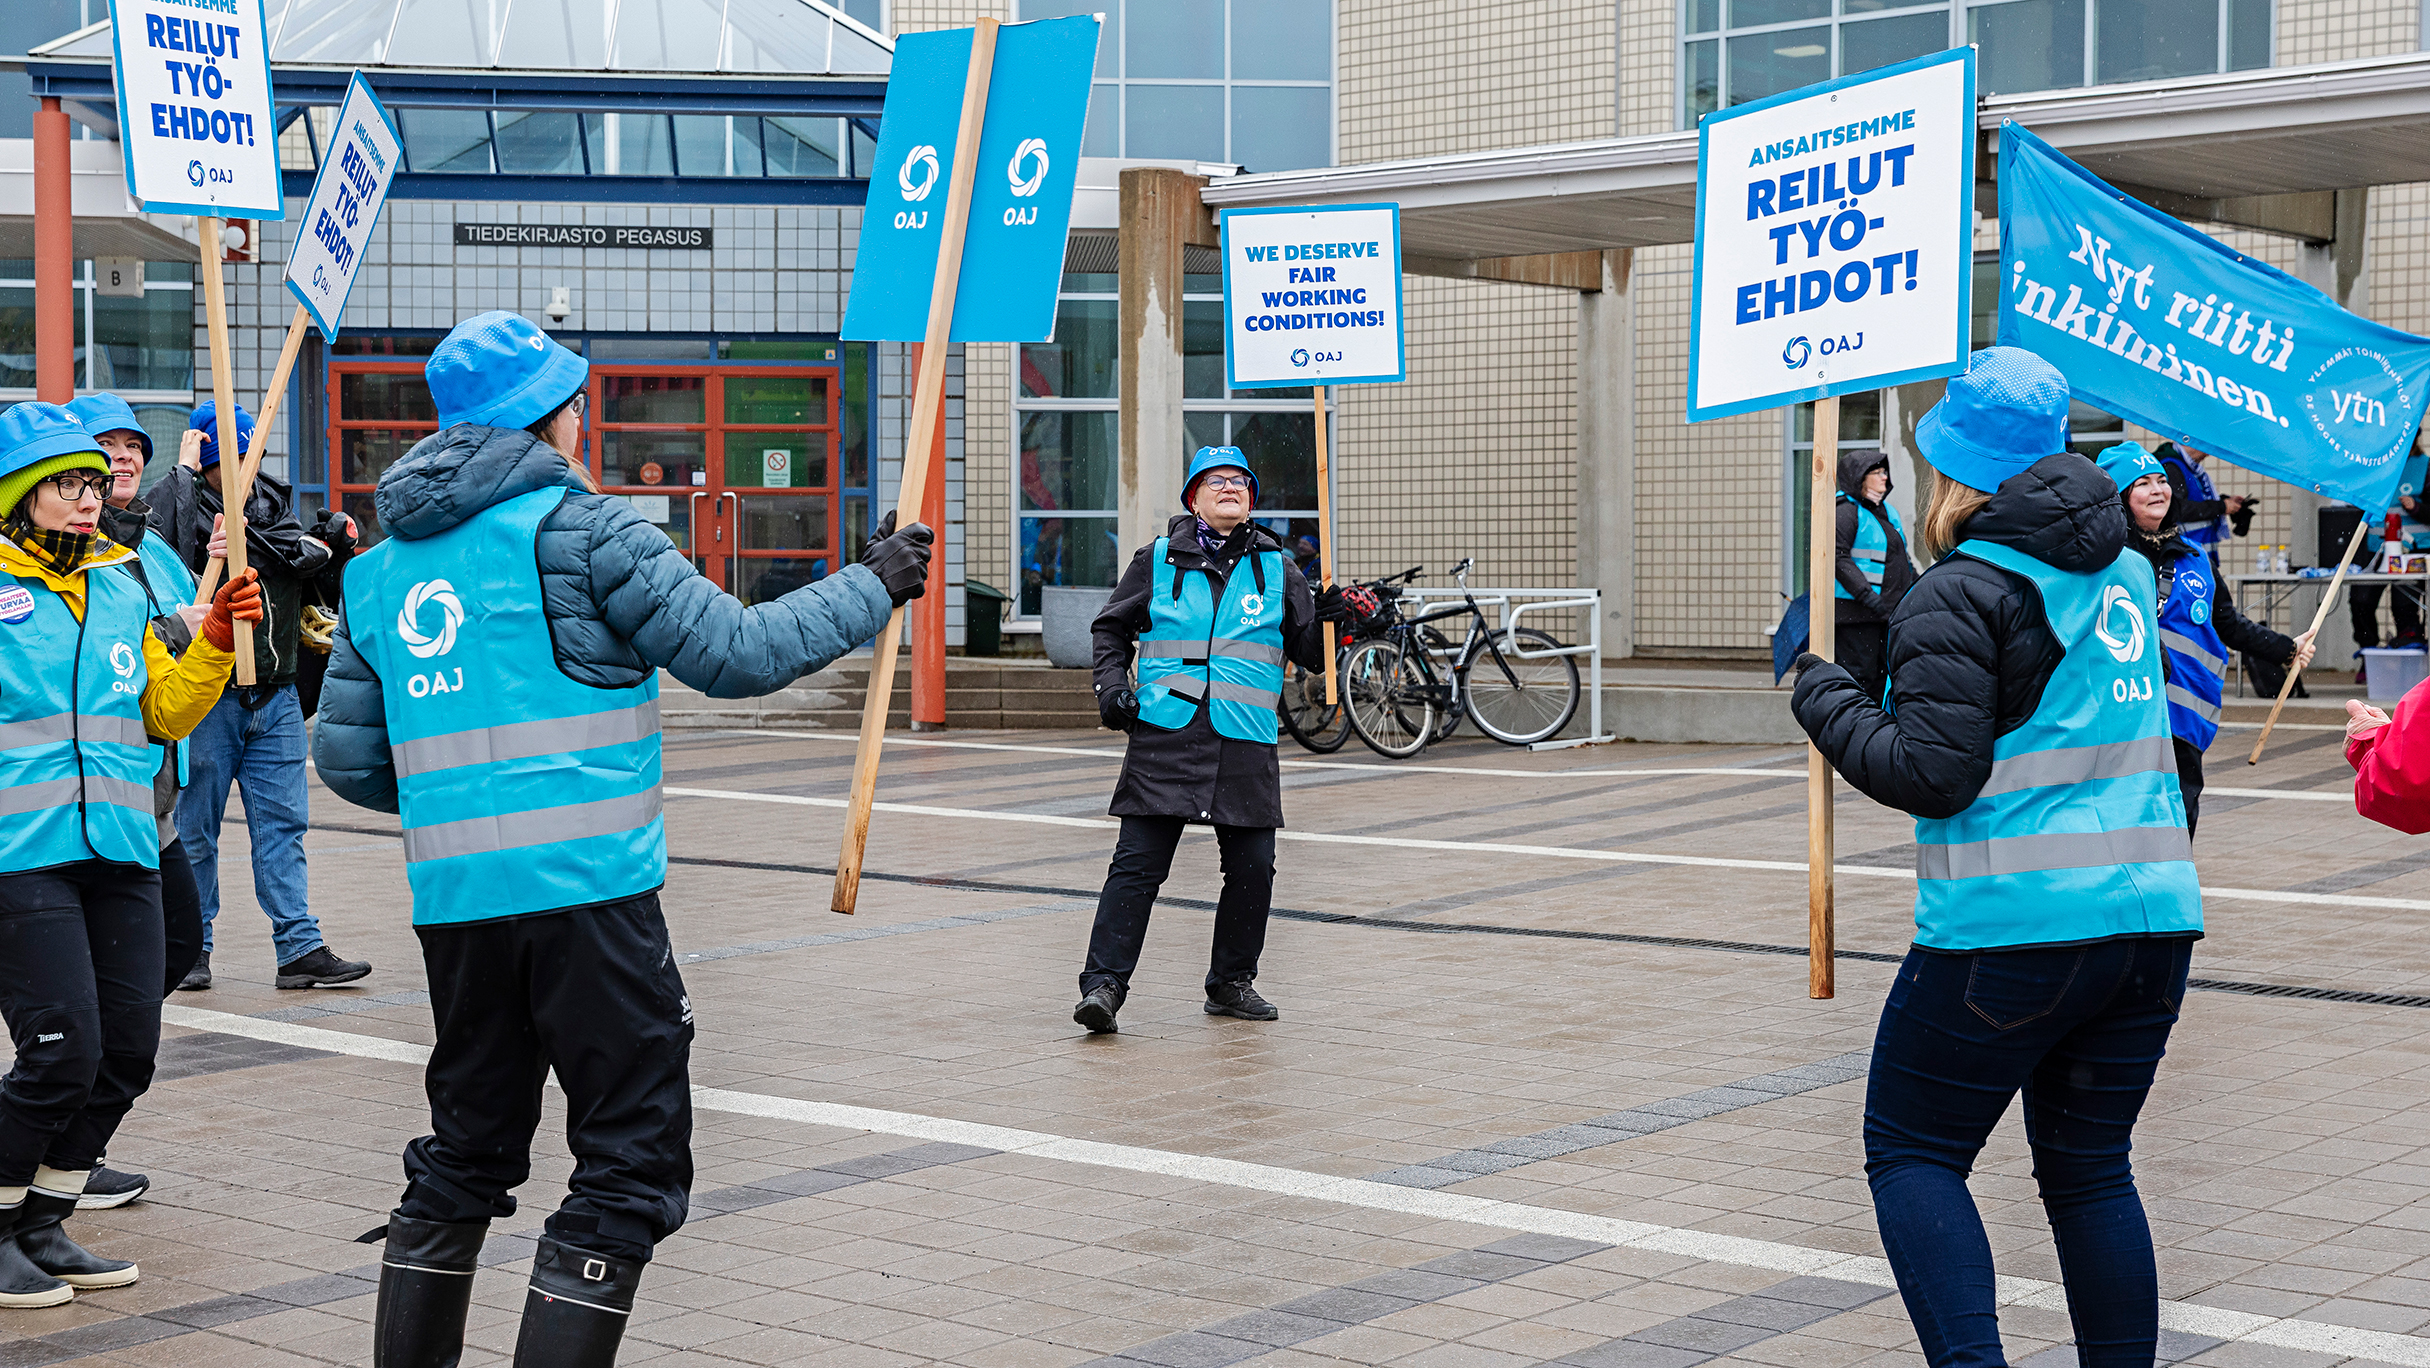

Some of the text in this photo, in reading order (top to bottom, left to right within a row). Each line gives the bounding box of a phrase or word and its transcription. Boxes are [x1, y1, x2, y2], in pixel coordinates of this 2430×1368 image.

[145, 13, 240, 59] REILUT
[165, 56, 232, 100] TYÖ-
[151, 103, 254, 147] EHDOT!
[353, 119, 386, 174] ANSAITSEMME
[1748, 109, 1915, 168] ANSAITSEMME
[209, 168, 233, 184] OAJ
[340, 140, 377, 206] REILUT
[1747, 144, 1915, 221] REILUT
[335, 181, 360, 229] TYÖ-
[1003, 207, 1037, 226] OAJ
[893, 211, 928, 230] OAJ
[1769, 198, 1885, 266] TYÖ-
[314, 207, 354, 276] EHDOT!
[465, 225, 702, 246] TIEDEKIRJASTO PEGASUS
[1245, 241, 1379, 262] WE DESERVE
[111, 270, 121, 286] B
[321, 277, 331, 295] OAJ
[1289, 266, 1336, 284] FAIR
[1736, 249, 1919, 326] EHDOT!
[1261, 288, 1366, 308] WORKING
[2068, 223, 2294, 372] Nyt riitti
[1244, 311, 1385, 332] CONDITIONS!
[1820, 332, 1864, 355] OAJ
[1315, 350, 1343, 363] OAJ
[2308, 347, 2353, 382] YLEMMÄT
[2330, 389, 2385, 427] ytn
[0, 597, 31, 610] URVAA
[1240, 616, 1260, 627] OAJ
[112, 681, 138, 695] OAJ
[407, 669, 464, 699] OAJ
[2112, 676, 2154, 703] OAJ
[37, 1032, 64, 1043] TIERRA
